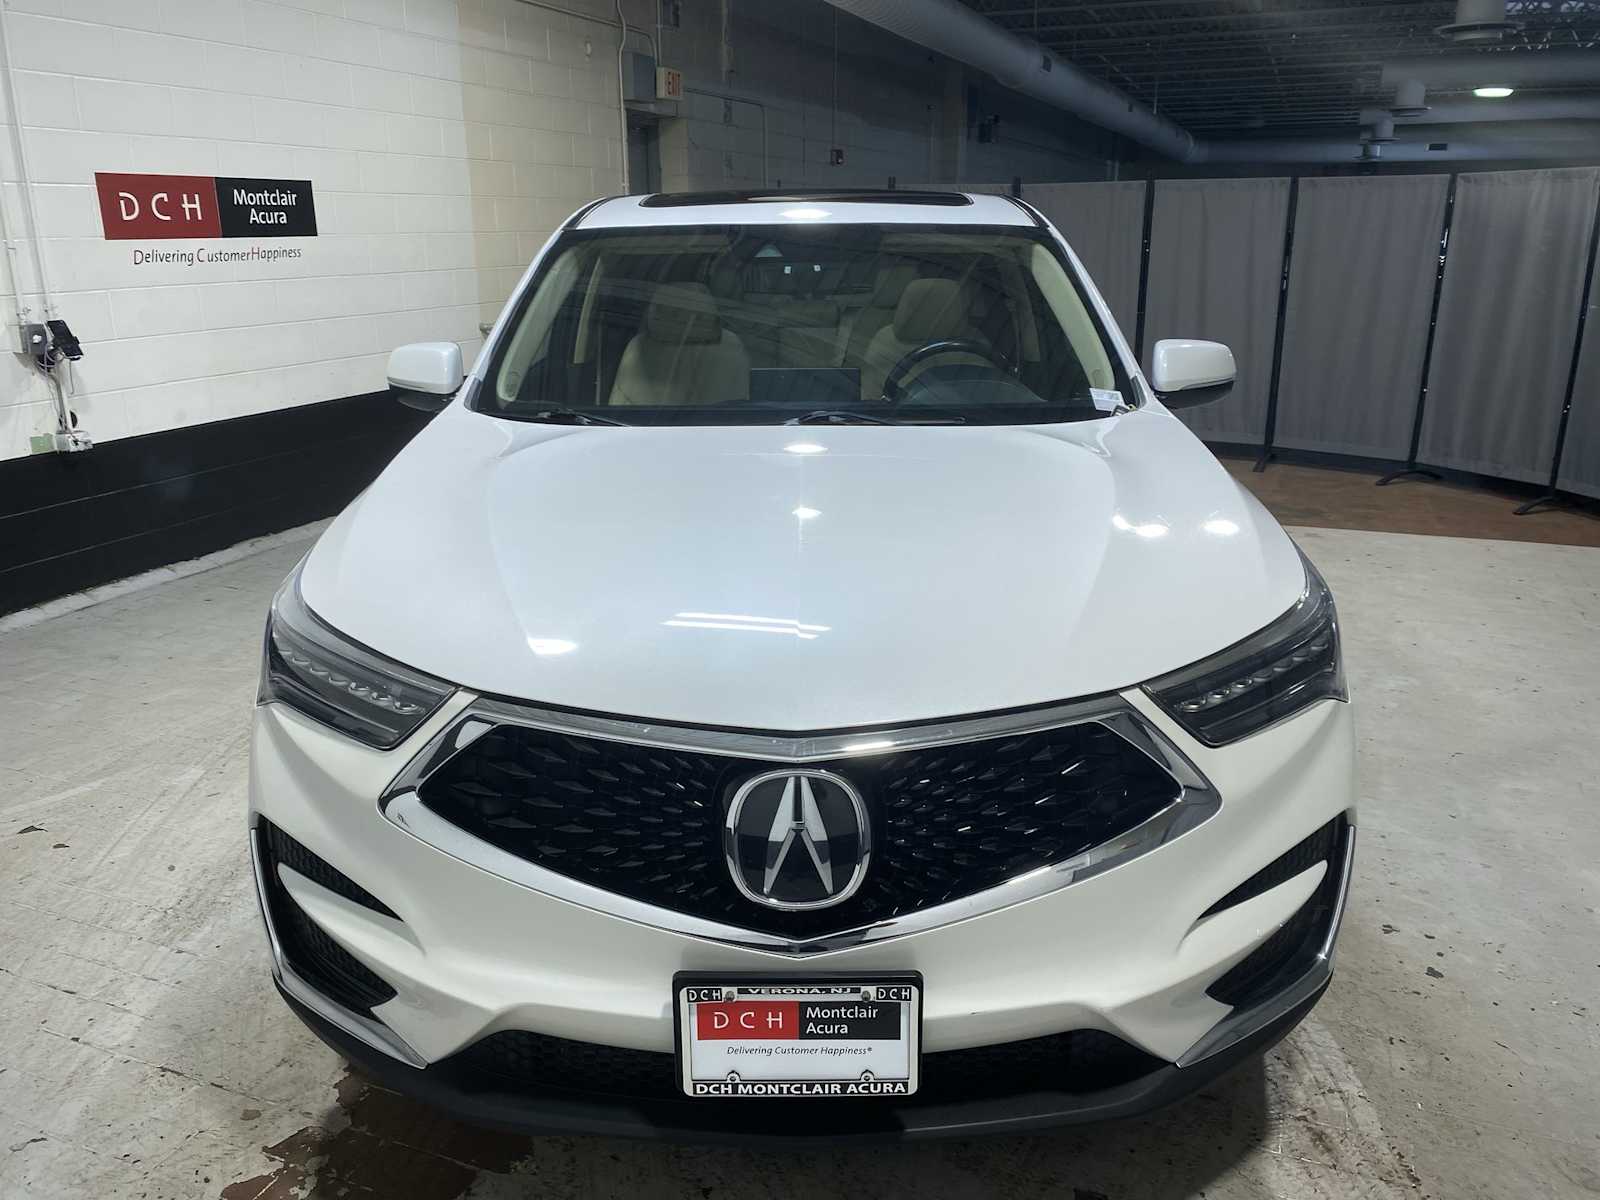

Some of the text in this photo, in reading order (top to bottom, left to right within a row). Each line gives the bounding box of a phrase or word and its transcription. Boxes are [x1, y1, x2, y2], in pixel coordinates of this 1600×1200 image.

[233, 188, 297, 206] Montclair
[249, 208, 287, 225] Acura
[133, 246, 301, 266] Delivering Customer Happiness
[806, 1006, 879, 1019] Montclair
[806, 1022, 849, 1034] Acura
[727, 1046, 773, 1056] Delivering
[774, 1046, 818, 1055] Customer
[696, 1081, 906, 1095] DCH MONTCLAIR ACURA
